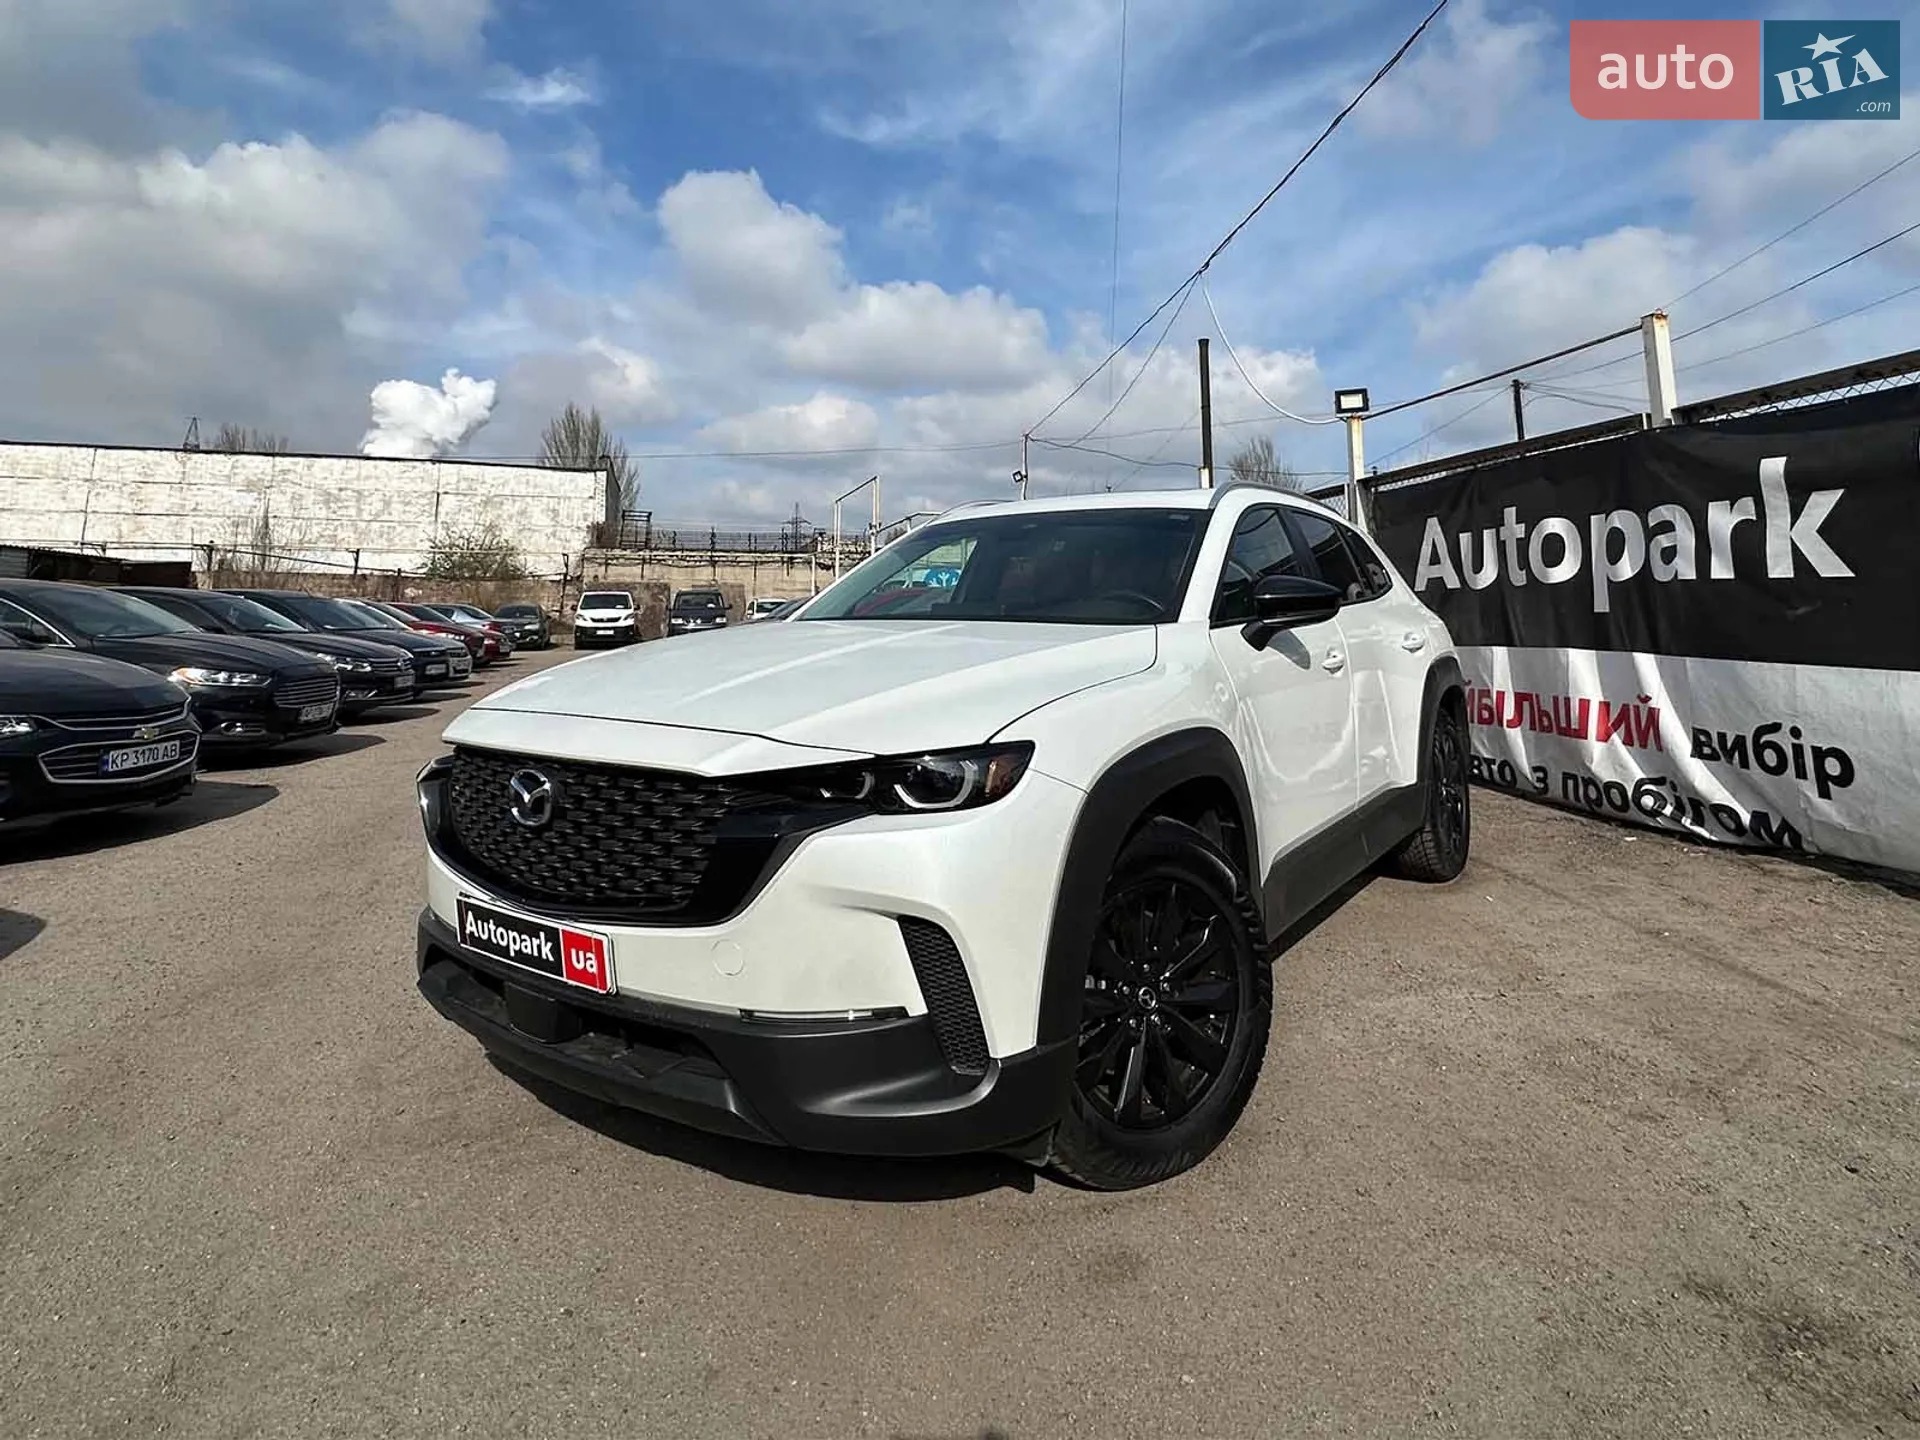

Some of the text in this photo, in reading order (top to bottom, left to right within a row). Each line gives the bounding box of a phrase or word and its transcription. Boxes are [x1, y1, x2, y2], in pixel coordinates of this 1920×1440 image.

[1414, 456, 1855, 613] Autopark
[110, 743, 179, 769] KP 3170 AB
[1690, 722, 1855, 800] вибір
[465, 910, 599, 974] Autopark ua
